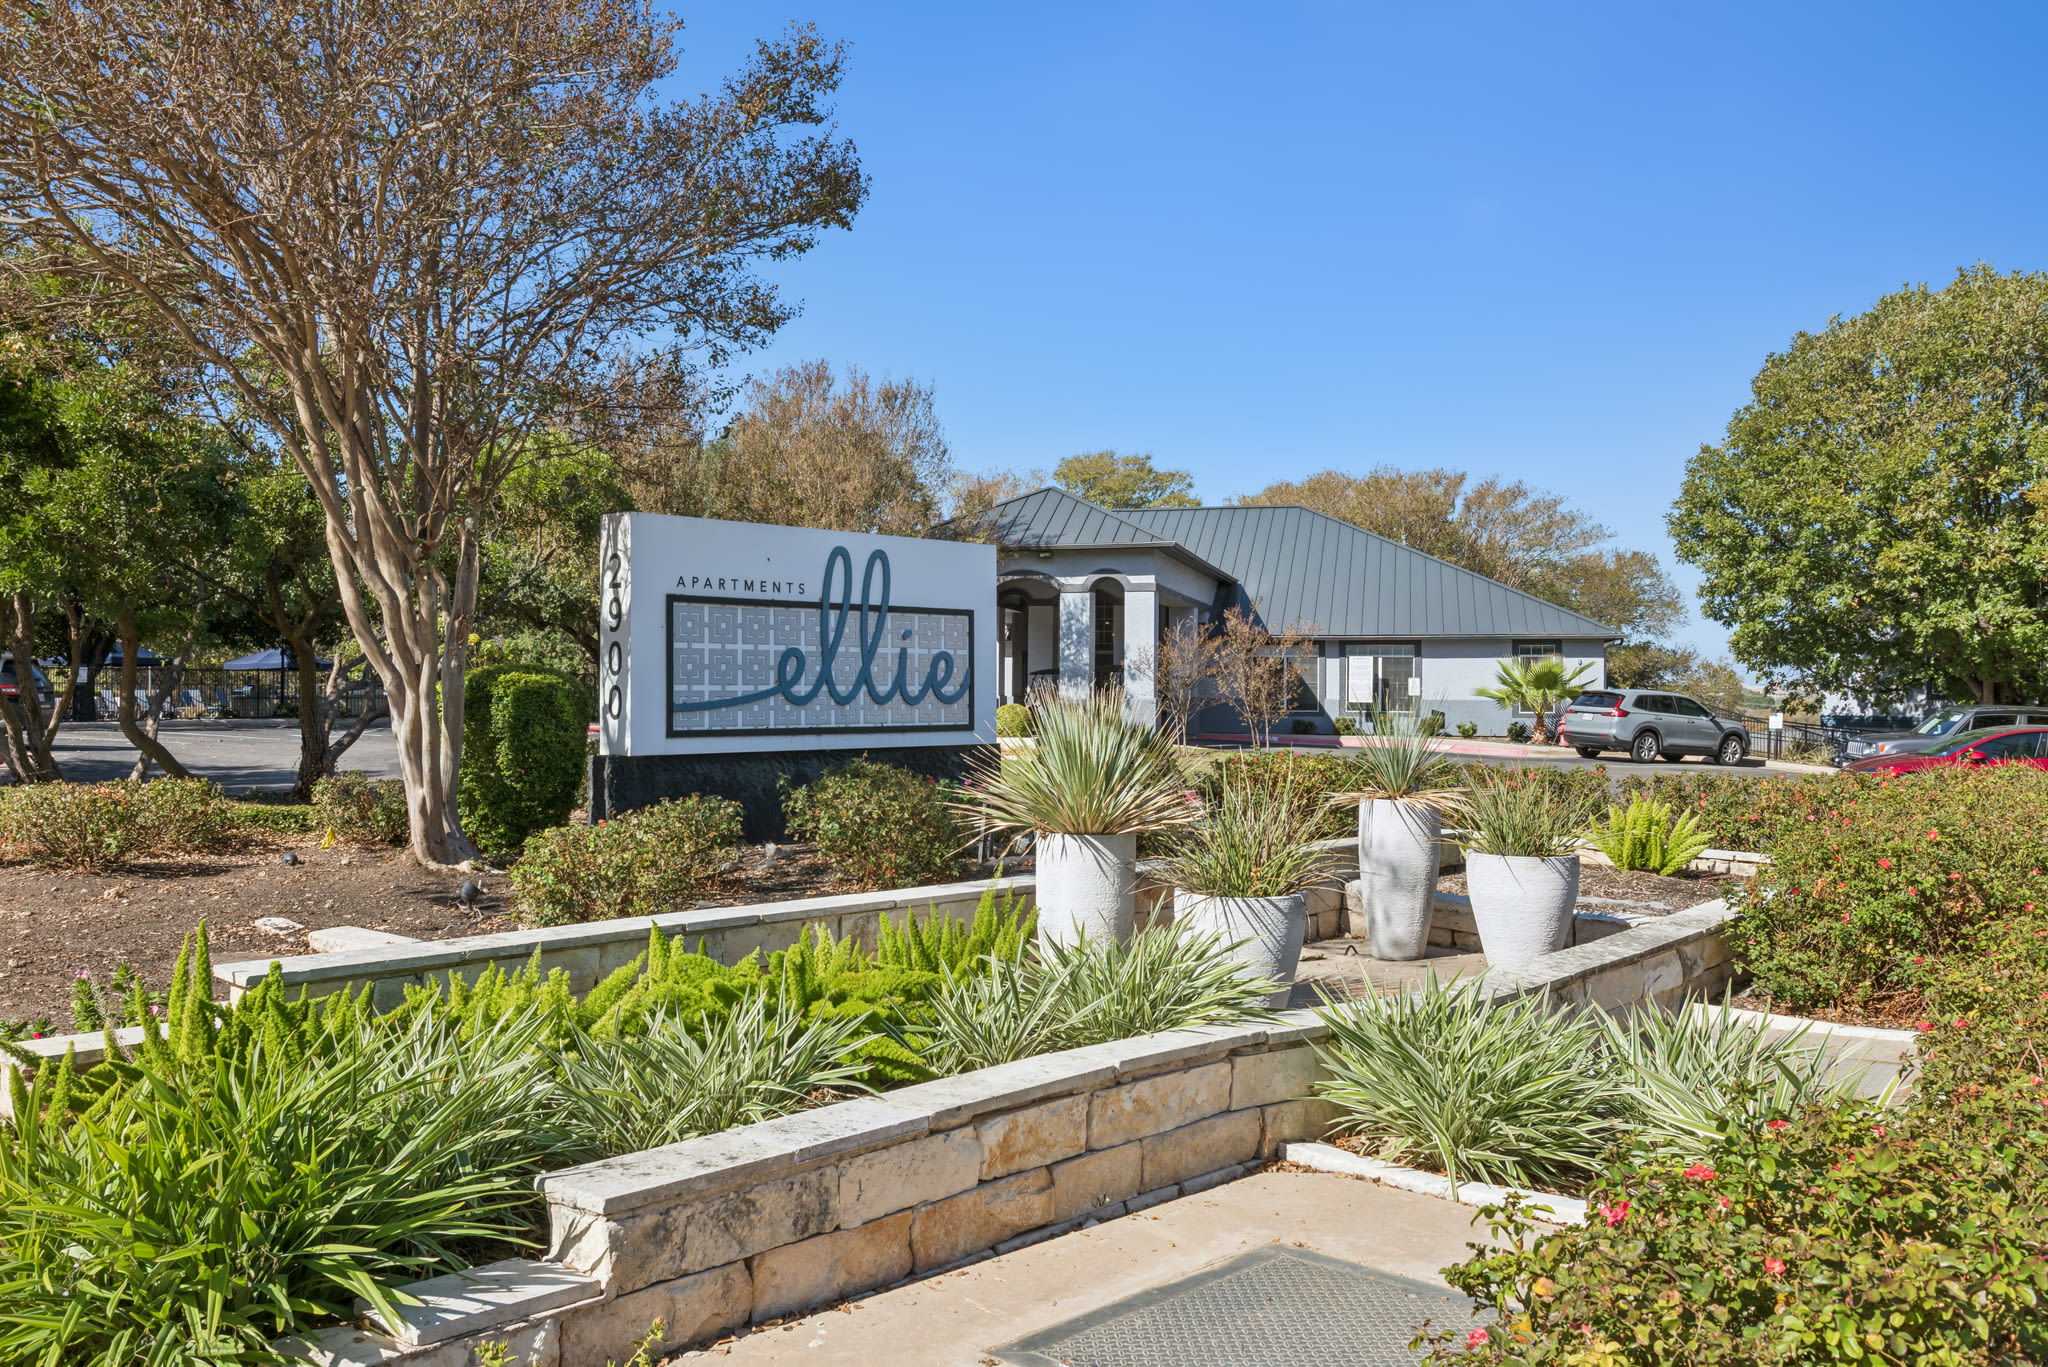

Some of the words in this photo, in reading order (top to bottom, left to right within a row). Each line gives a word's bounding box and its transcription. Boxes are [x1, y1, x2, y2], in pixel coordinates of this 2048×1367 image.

[608, 552, 622, 720] 2900
[673, 545, 970, 712] ellie
[676, 575, 805, 595] APARTMENTS
